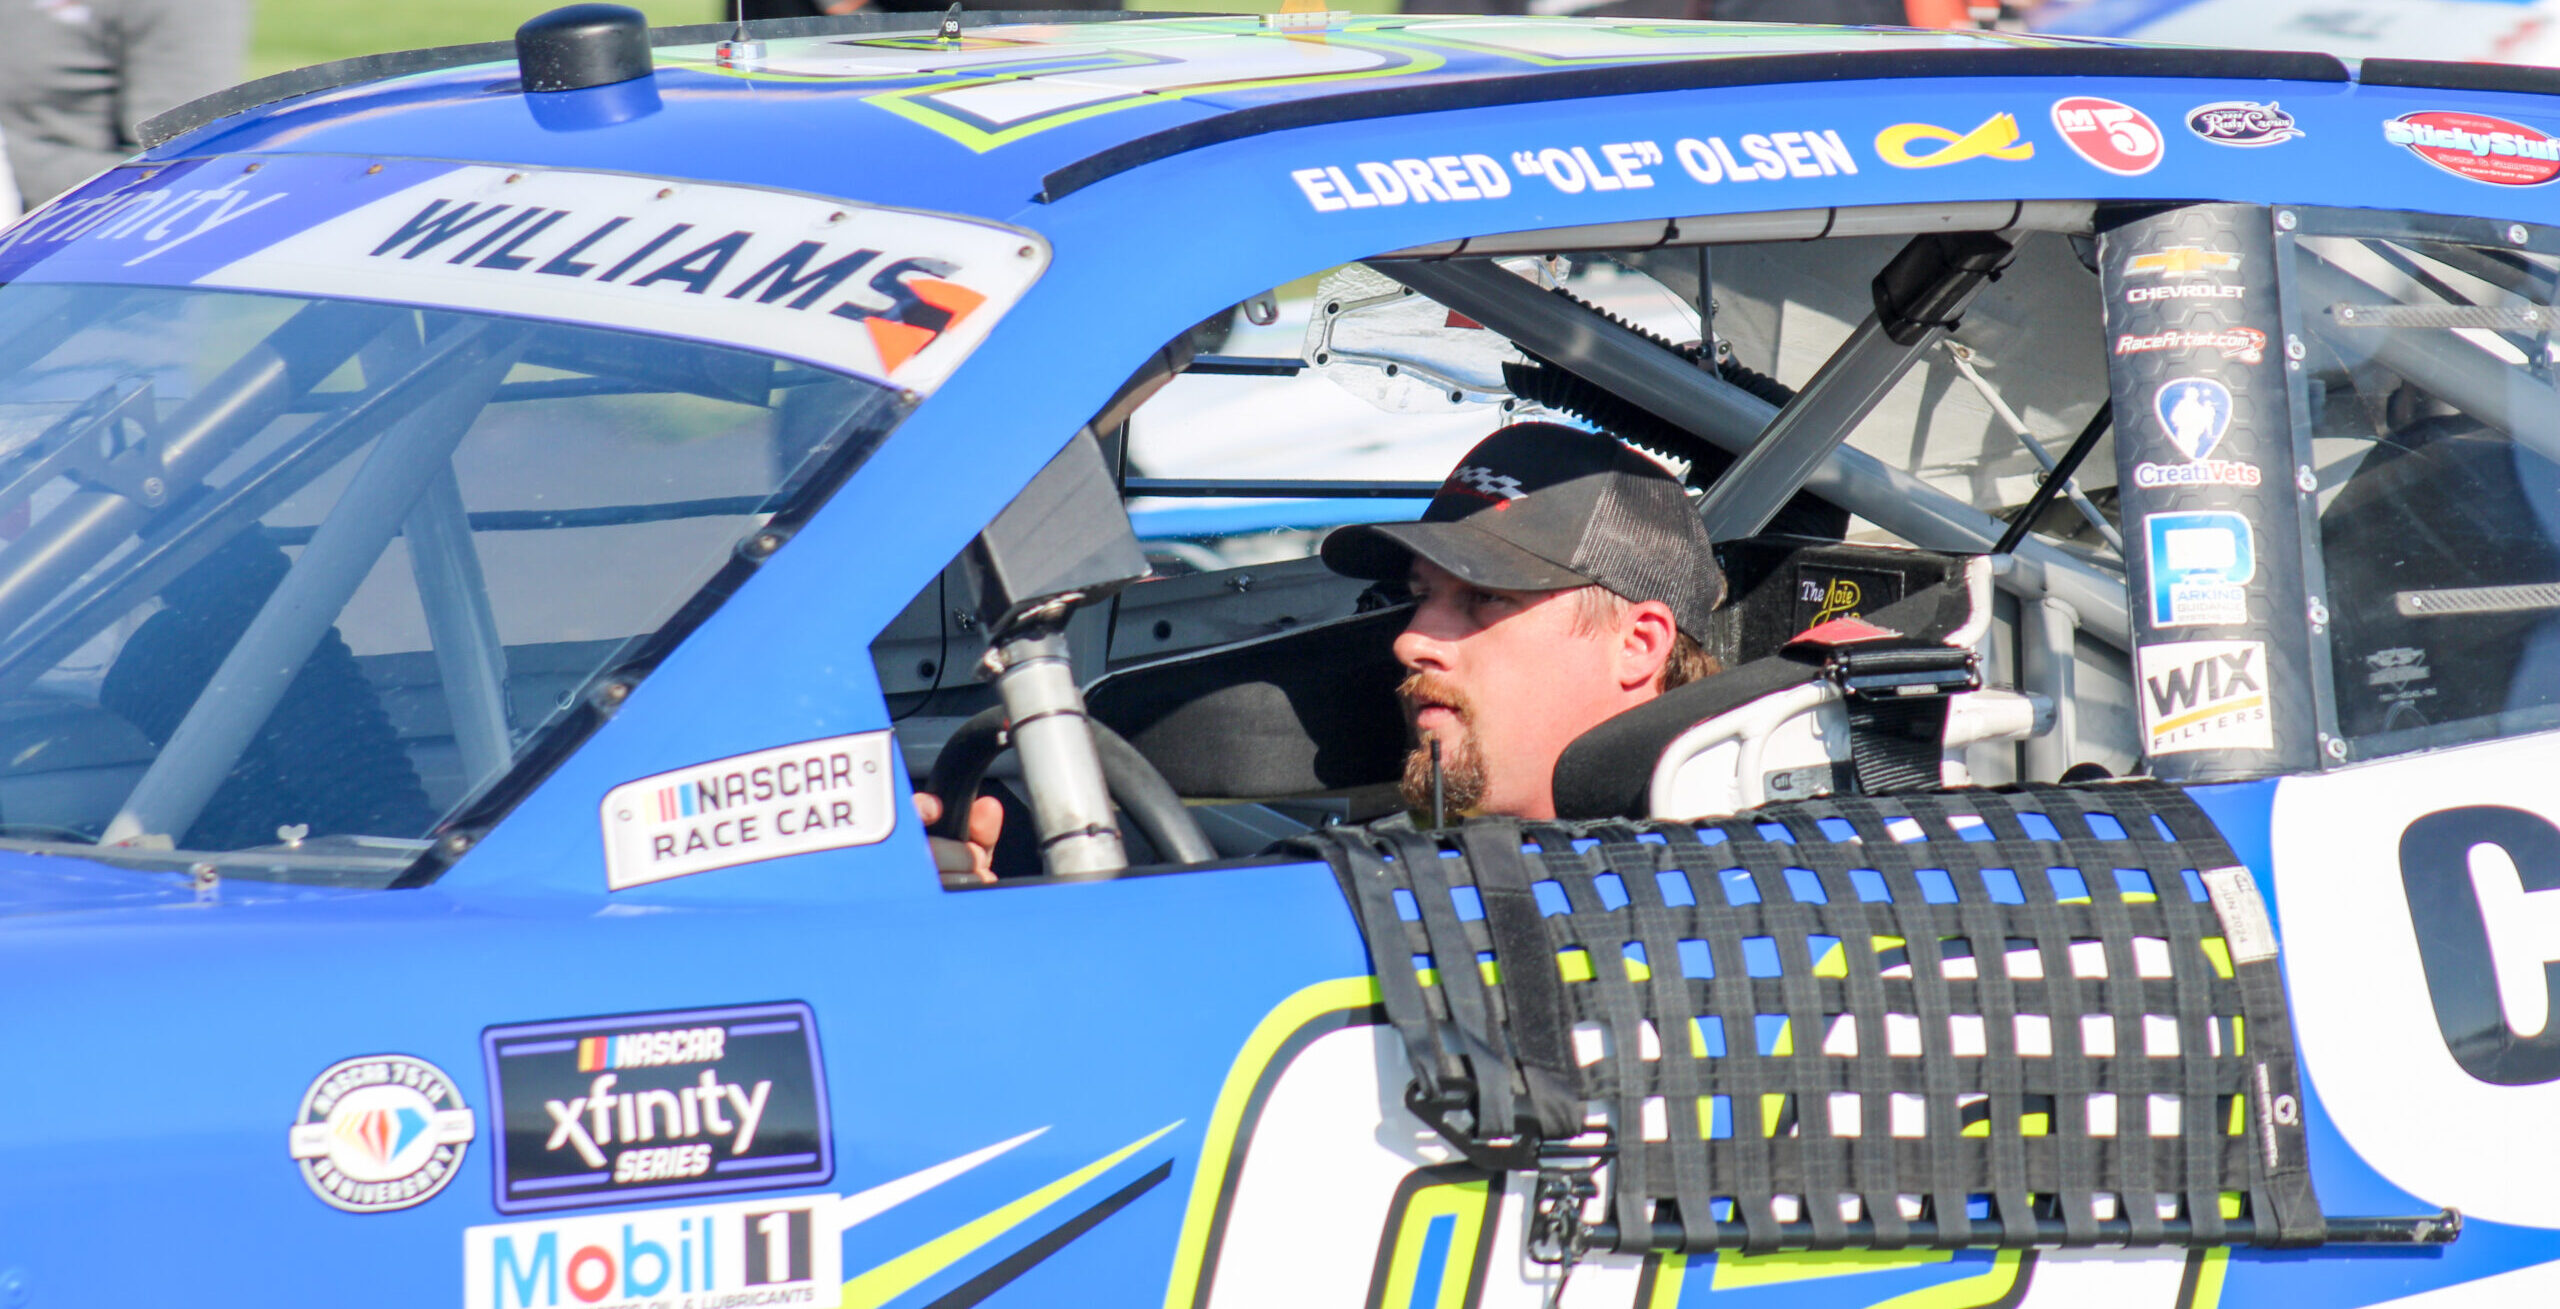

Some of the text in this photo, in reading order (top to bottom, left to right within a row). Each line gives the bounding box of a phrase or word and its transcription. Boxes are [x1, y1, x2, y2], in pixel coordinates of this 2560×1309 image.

[1292, 153, 1512, 212] ELDRED
[1675, 129, 1858, 184] OLSEN
[368, 198, 962, 358] WILLIAMS
[2127, 285, 2246, 303] CHEVROLET
[2116, 330, 2251, 355] RaceArtist.com
[2138, 464, 2259, 485] CreatiVets
[1801, 580, 1825, 603] The
[2147, 648, 2260, 718] WIX
[2154, 708, 2264, 750] FILTERS
[697, 752, 854, 814] NASCAR
[653, 801, 857, 861] RACE CAR
[613, 1026, 726, 1070] NASCAR
[544, 1068, 772, 1168] xfinity
[313, 1145, 453, 1206] ANNIVERSARY
[613, 1143, 713, 1184] SERIES
[492, 1216, 714, 1309] Mobil
[702, 1287, 814, 1309] LUBRICANTS
